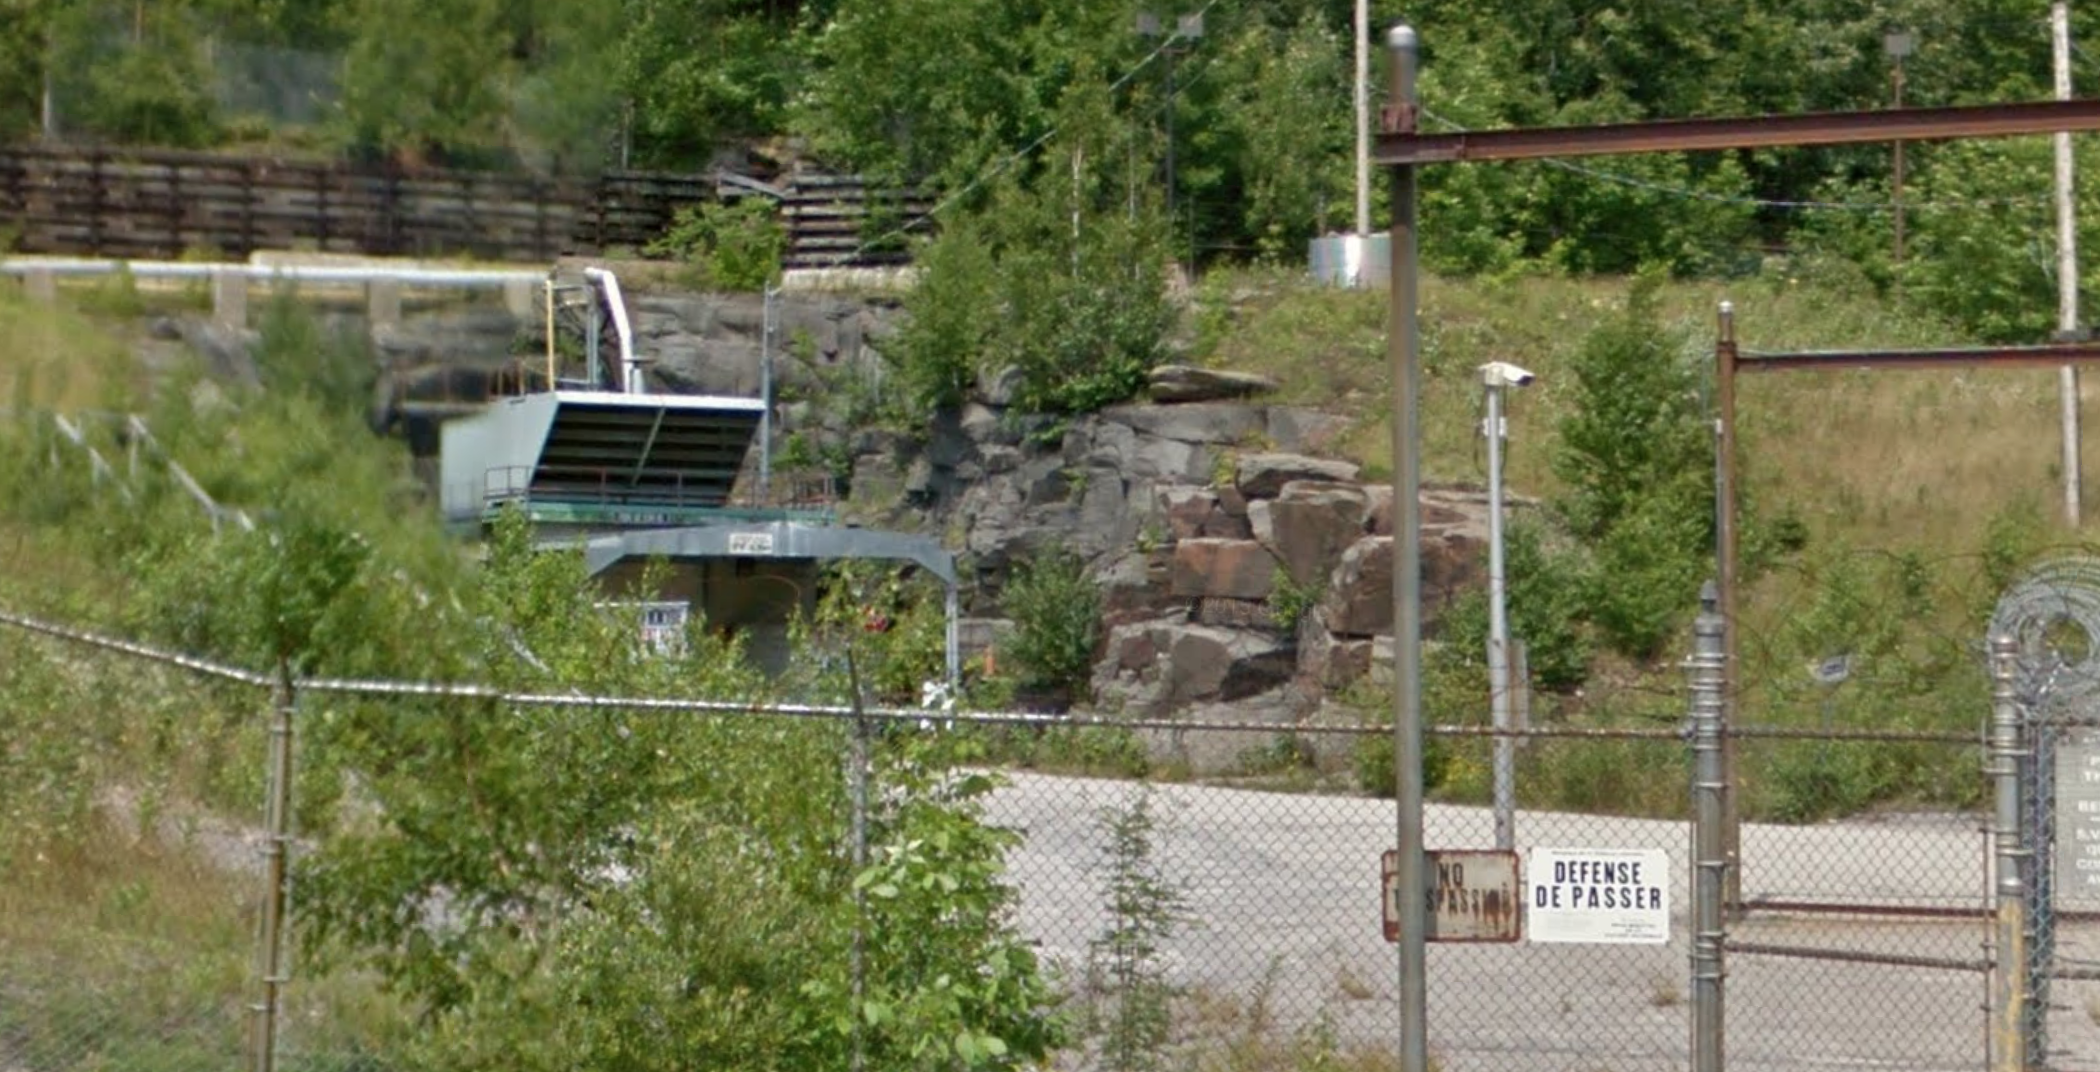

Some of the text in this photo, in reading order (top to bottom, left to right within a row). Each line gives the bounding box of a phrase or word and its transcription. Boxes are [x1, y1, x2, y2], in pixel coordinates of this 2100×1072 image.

[1438, 862, 1464, 888] NO
[1554, 861, 1642, 885] DEFENSE
[1536, 885, 1661, 909] DE PASSER
